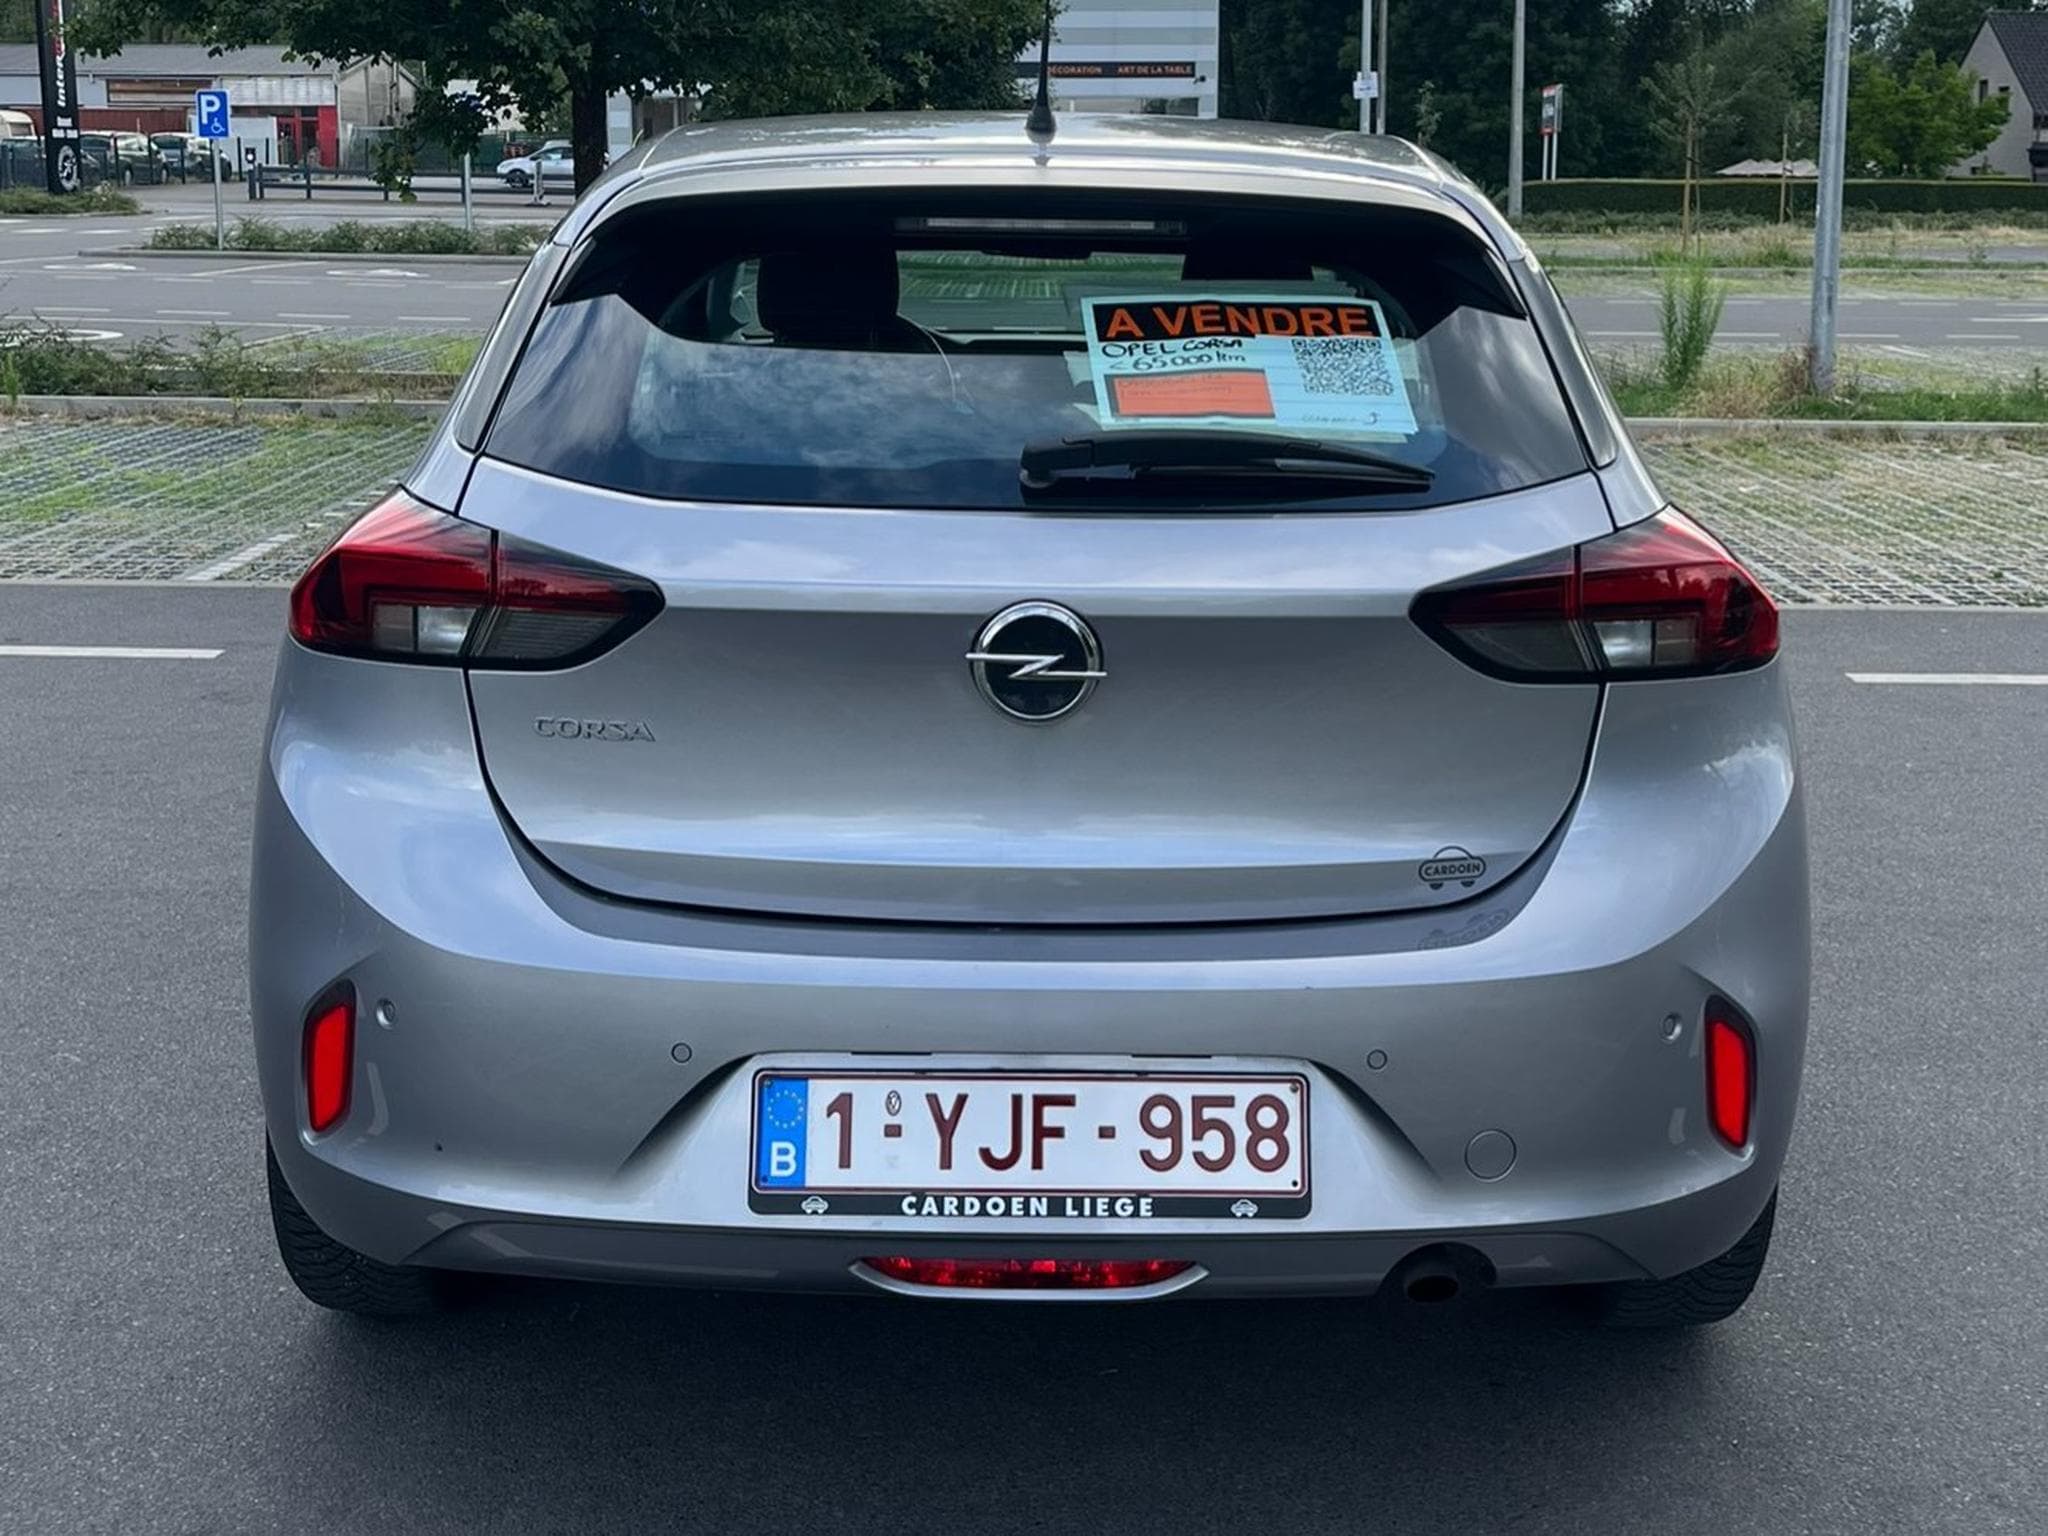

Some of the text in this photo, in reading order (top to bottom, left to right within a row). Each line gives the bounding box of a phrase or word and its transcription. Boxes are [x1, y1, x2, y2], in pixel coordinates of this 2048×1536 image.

[1117, 65, 1193, 75] ART DE LA TABLE
[200, 94, 221, 125] P
[1106, 304, 1374, 338] A VENDRE
[1101, 338, 1243, 359] OPEL CORSA
[534, 716, 656, 742] CORSA
[1424, 863, 1481, 876] CARDOEN
[768, 1140, 797, 1178] B
[900, 1195, 1155, 1219] CARDOEN LIEGE
